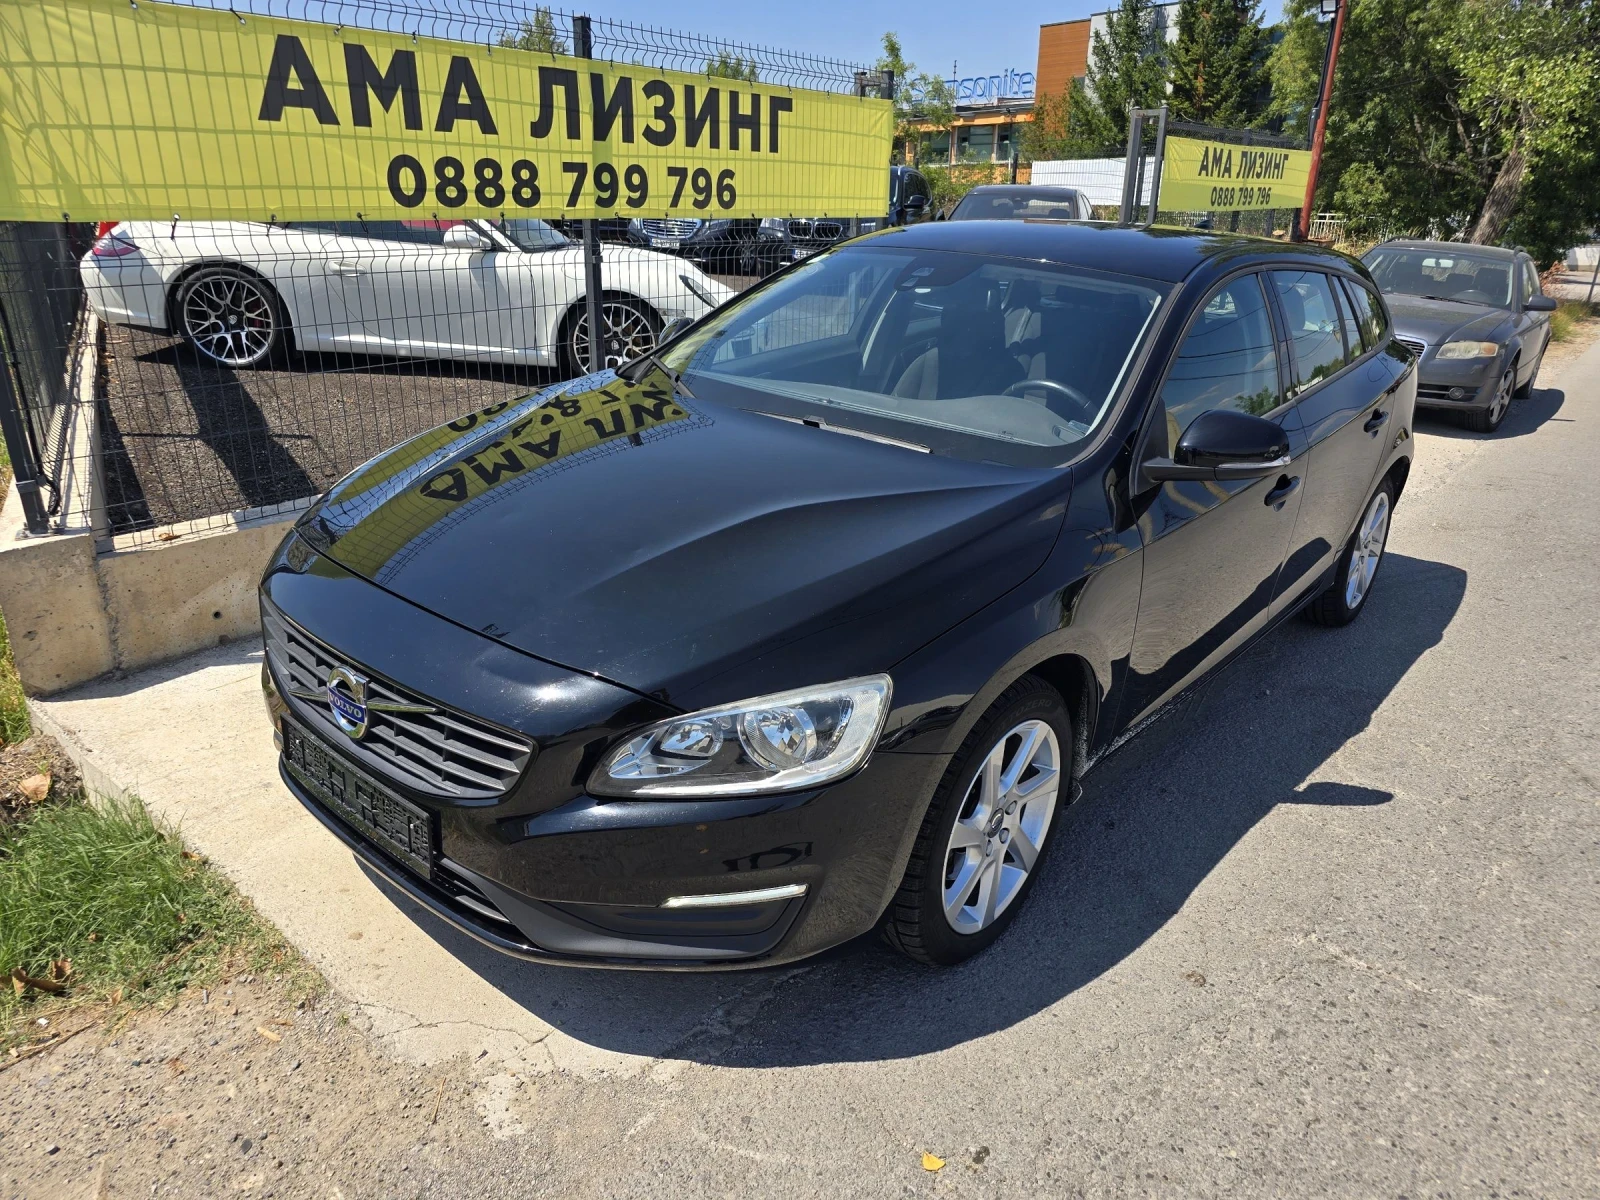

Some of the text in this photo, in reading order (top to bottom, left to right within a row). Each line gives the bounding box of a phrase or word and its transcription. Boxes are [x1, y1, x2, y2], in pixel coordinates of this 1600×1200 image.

[258, 34, 793, 154] АМА ЛИЗИНГ
[1198, 146, 1289, 179] АМА ЛИЗИНГ
[387, 154, 737, 210] 0888 799 796
[1210, 186, 1272, 207] 0888 799 796
[330, 692, 362, 718] VOLVO
